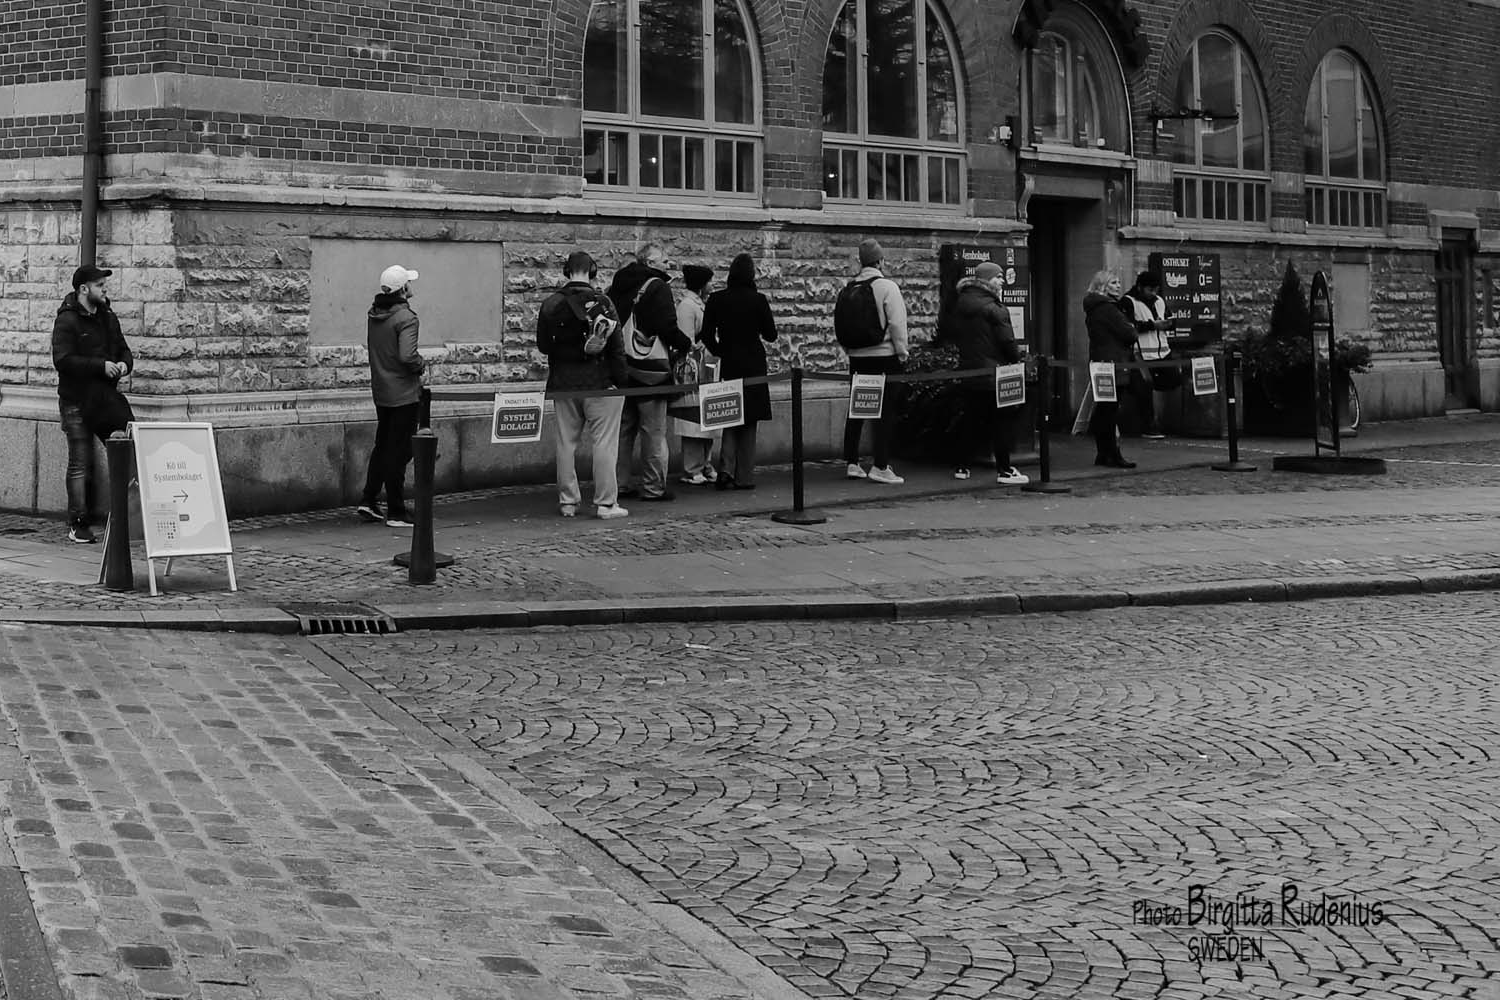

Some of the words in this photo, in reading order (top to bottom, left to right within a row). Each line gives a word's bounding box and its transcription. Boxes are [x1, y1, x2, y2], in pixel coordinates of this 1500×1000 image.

[707, 399, 737, 411] SYSTEM
[503, 413, 536, 422] SYSTEM
[706, 407, 740, 420] BOLAGET
[500, 422, 537, 431] BOLAGET
[165, 461, 177, 470] Kö
[153, 472, 203, 483] Systembolaget
